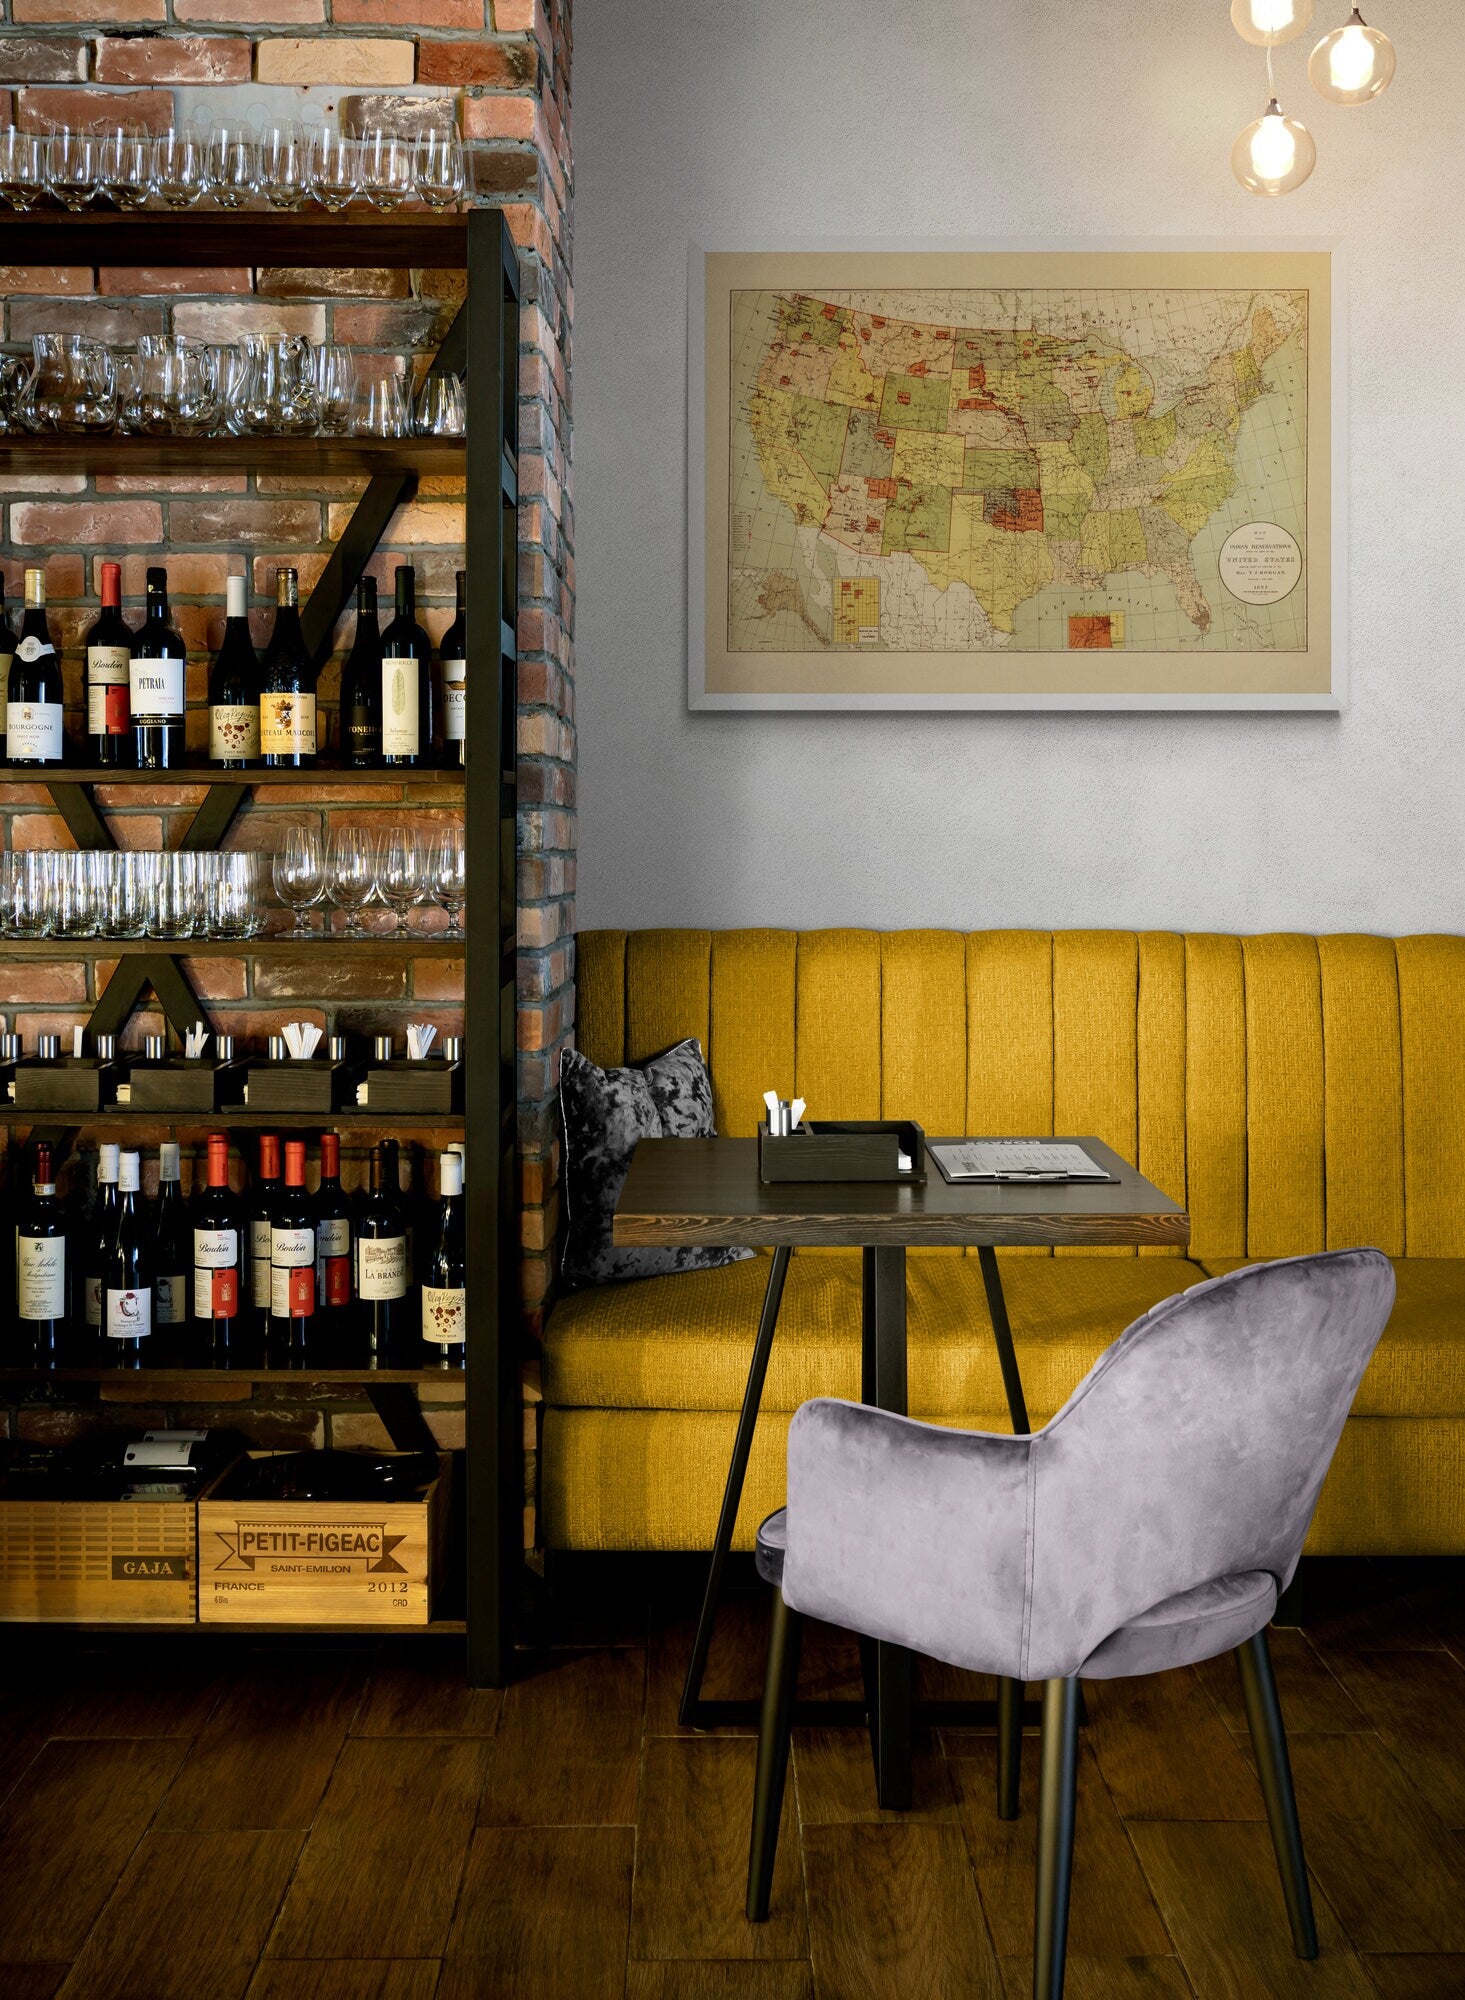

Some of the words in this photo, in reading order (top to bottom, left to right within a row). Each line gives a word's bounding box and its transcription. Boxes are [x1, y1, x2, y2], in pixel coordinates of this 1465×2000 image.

[92, 660, 123, 669] Bordón
[138, 678, 165, 689] PETRAIA
[320, 1233, 342, 1242] ordón
[199, 1243, 229, 1253] Bordón
[275, 1243, 306, 1252] Bordón
[364, 1269, 375, 1279] LA
[243, 1532, 380, 1552] PETIT-FIGEAC
[123, 1562, 174, 1575] GAJA
[271, 1564, 351, 1573] SAINT-EMILION
[214, 1582, 265, 1591] FRANCE
[368, 1582, 408, 1593] 2012
